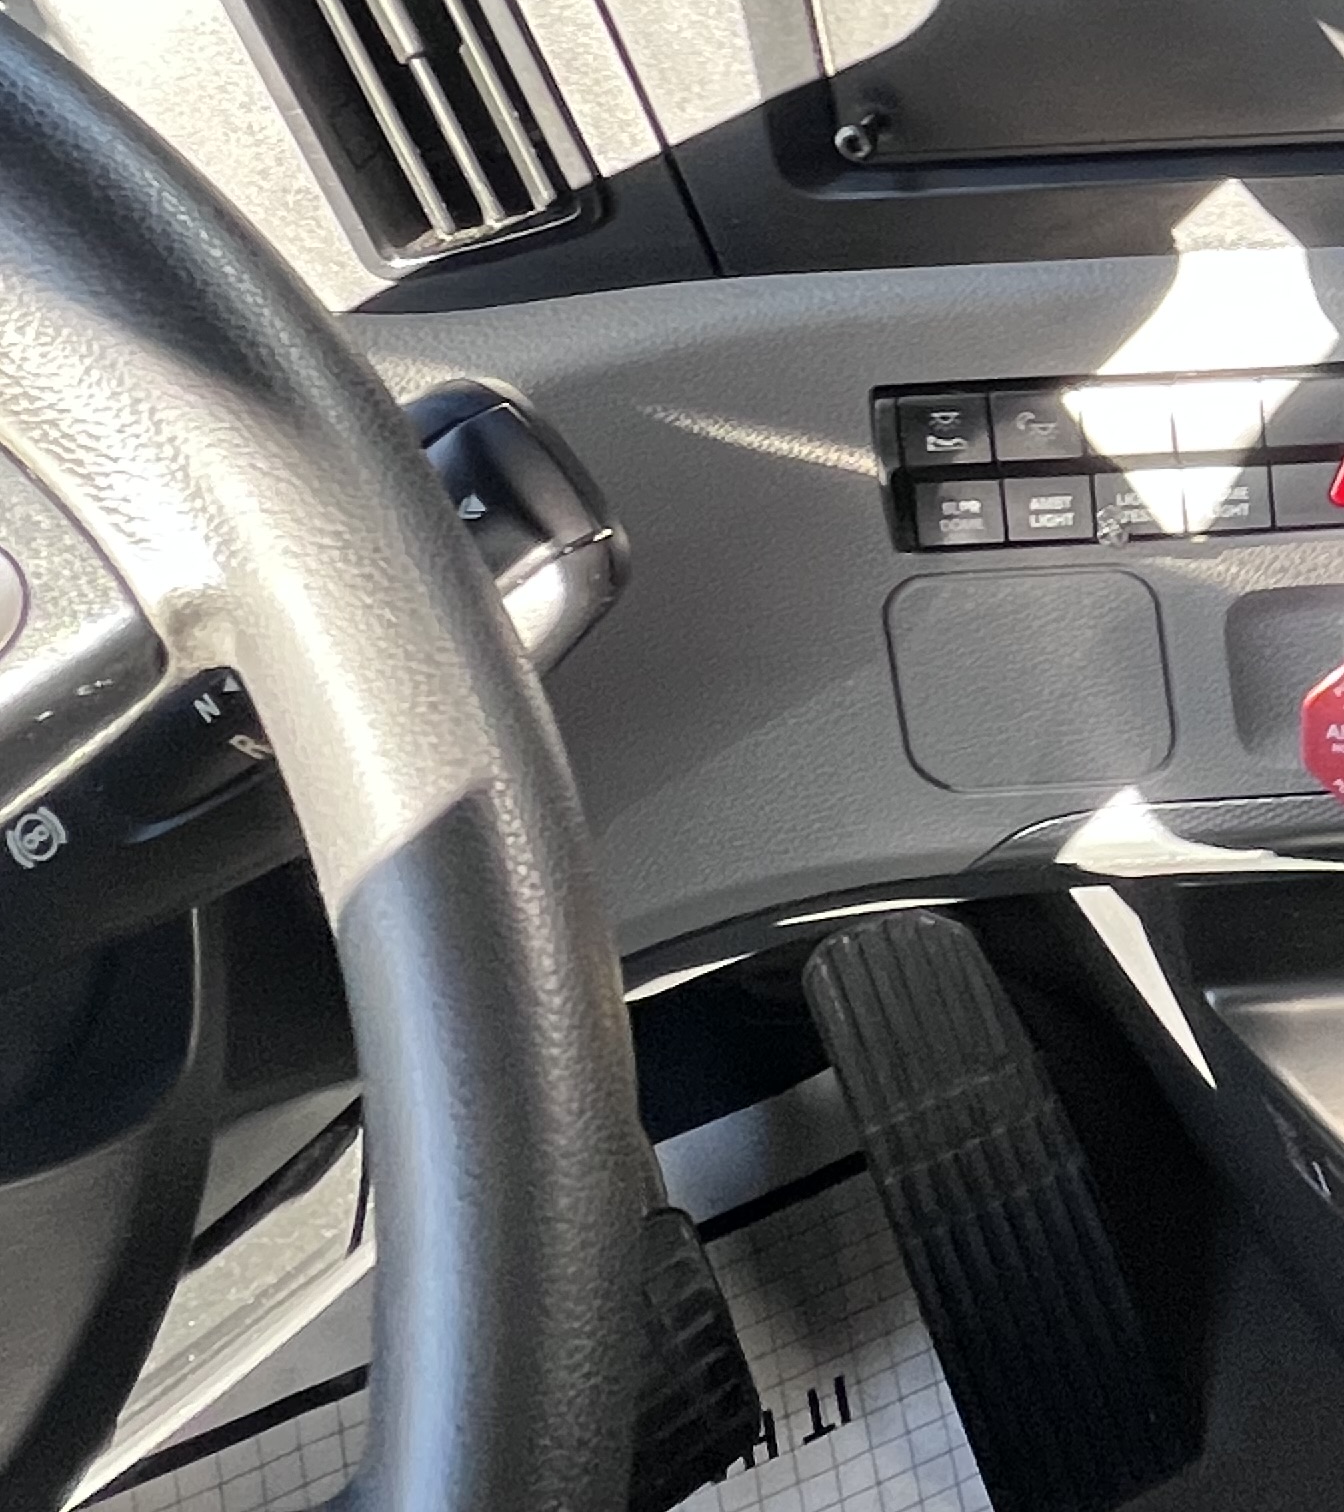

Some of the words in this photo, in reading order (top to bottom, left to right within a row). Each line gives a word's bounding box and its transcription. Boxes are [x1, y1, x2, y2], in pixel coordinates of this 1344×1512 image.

[1028, 512, 1075, 528] LIGHT
[193, 693, 221, 724] N
[228, 734, 275, 760] R
